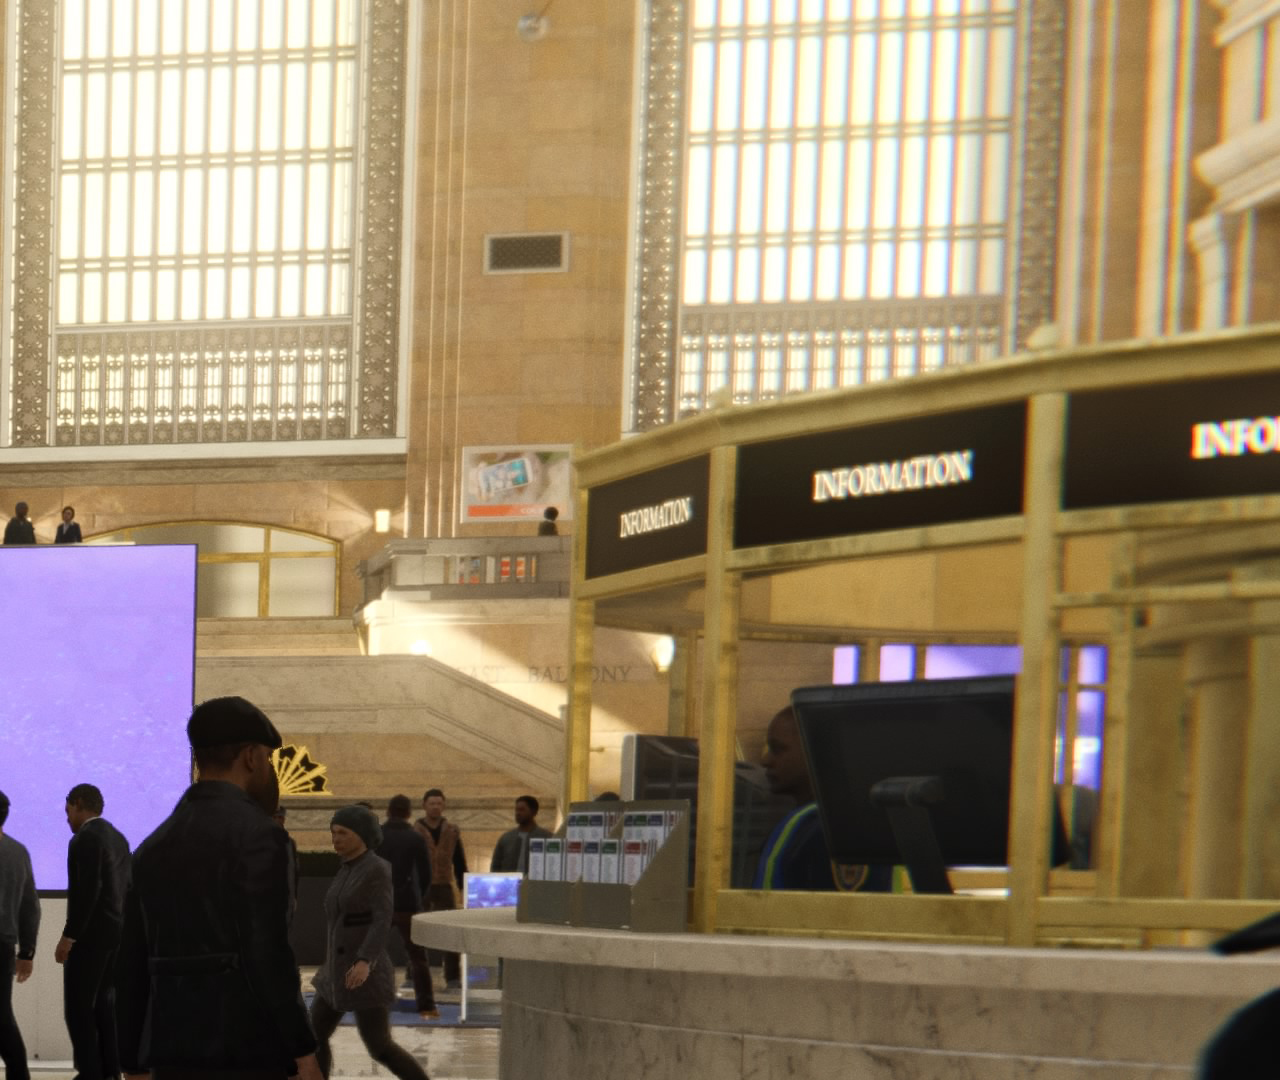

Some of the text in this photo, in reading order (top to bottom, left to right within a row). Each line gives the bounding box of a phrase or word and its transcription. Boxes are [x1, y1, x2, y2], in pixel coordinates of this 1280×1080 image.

[1191, 416, 1280, 460] INFO
[813, 449, 974, 502] INFORMATION
[620, 497, 692, 538] INFORMATION
[528, 665, 633, 683] BALONY
